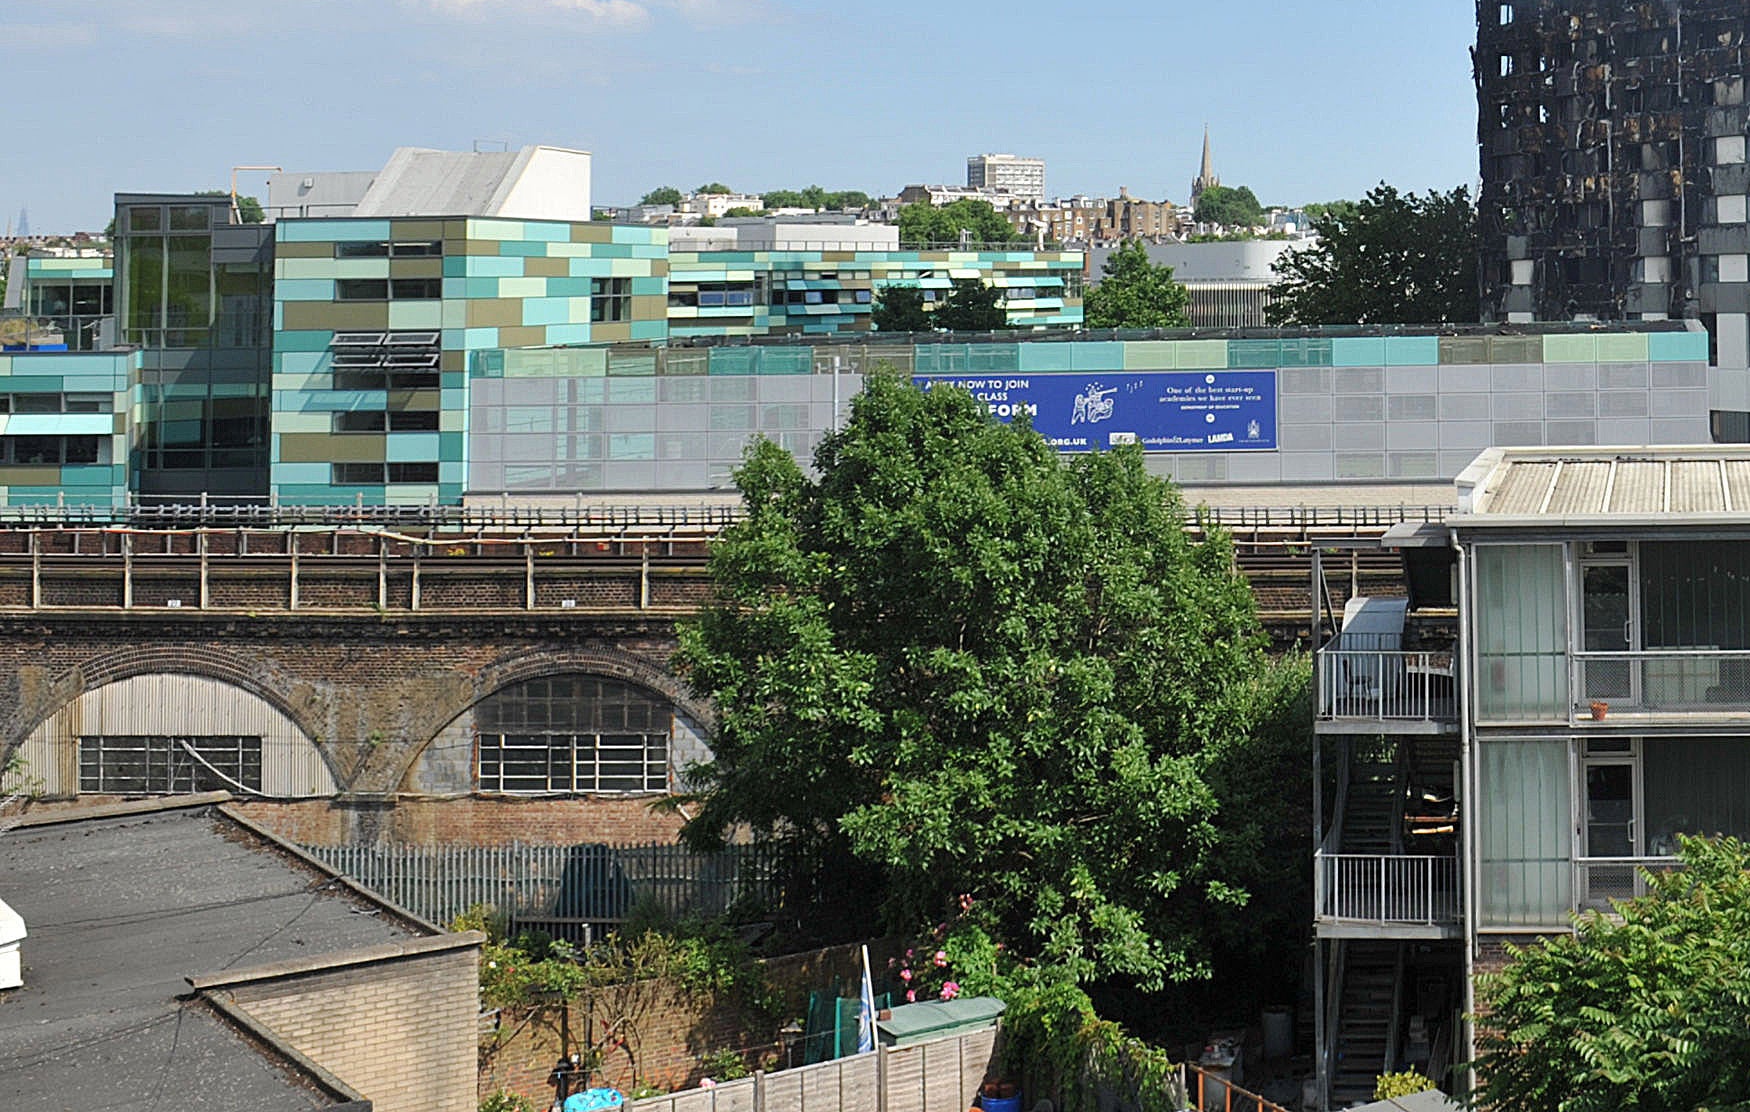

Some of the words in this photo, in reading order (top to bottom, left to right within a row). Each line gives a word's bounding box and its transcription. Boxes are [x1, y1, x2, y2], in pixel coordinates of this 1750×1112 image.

[958, 380, 986, 389] NOW
[988, 380, 1003, 389] TO
[1005, 380, 1029, 390] JOIN
[977, 392, 1008, 401] CLASS
[988, 404, 1038, 417] FORM
